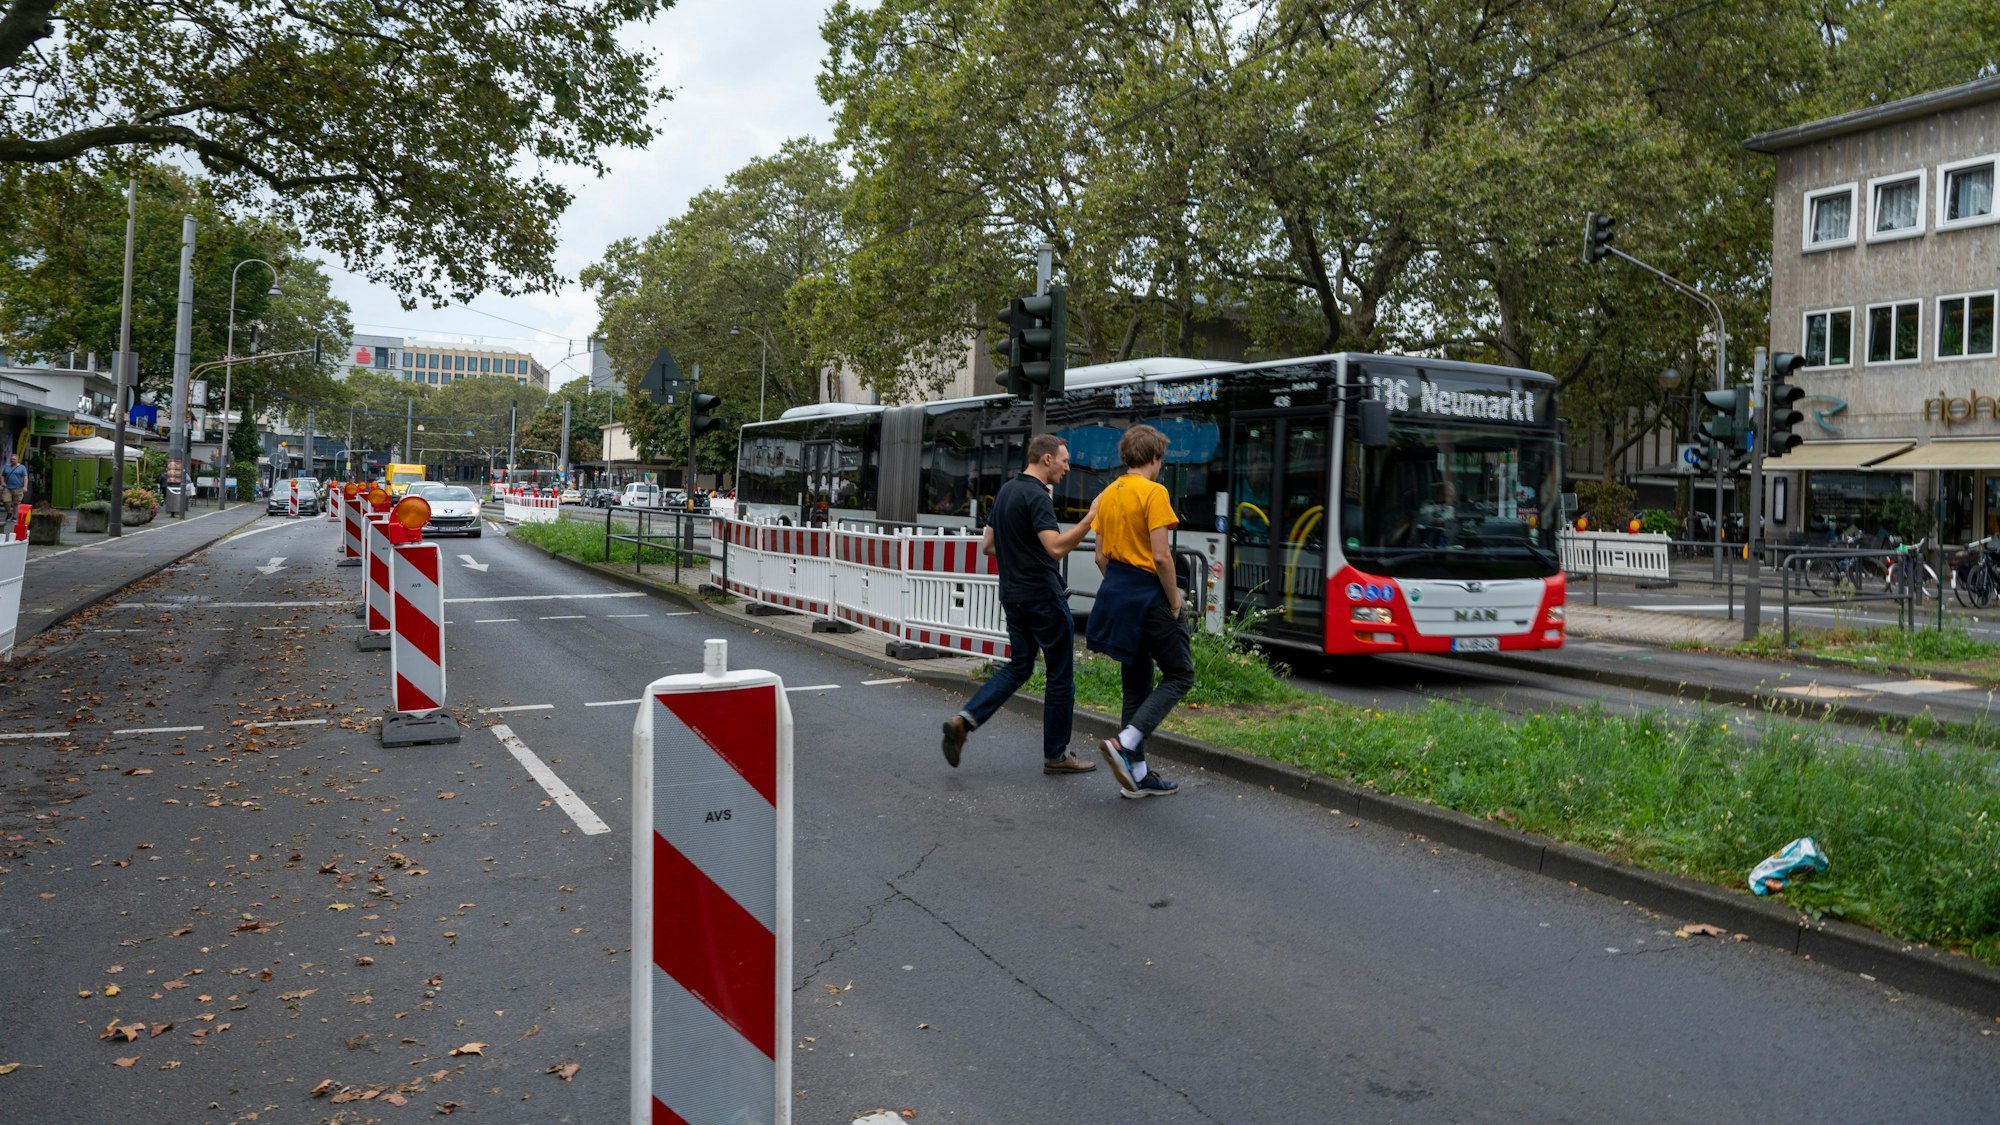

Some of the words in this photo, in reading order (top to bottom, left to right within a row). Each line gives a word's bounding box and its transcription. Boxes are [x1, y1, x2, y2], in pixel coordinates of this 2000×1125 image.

[1153, 378, 1217, 405] Neumarkt
[1420, 380, 1535, 422] Neumarkt
[1924, 388, 2000, 429] riph
[705, 809, 732, 823] AVS
